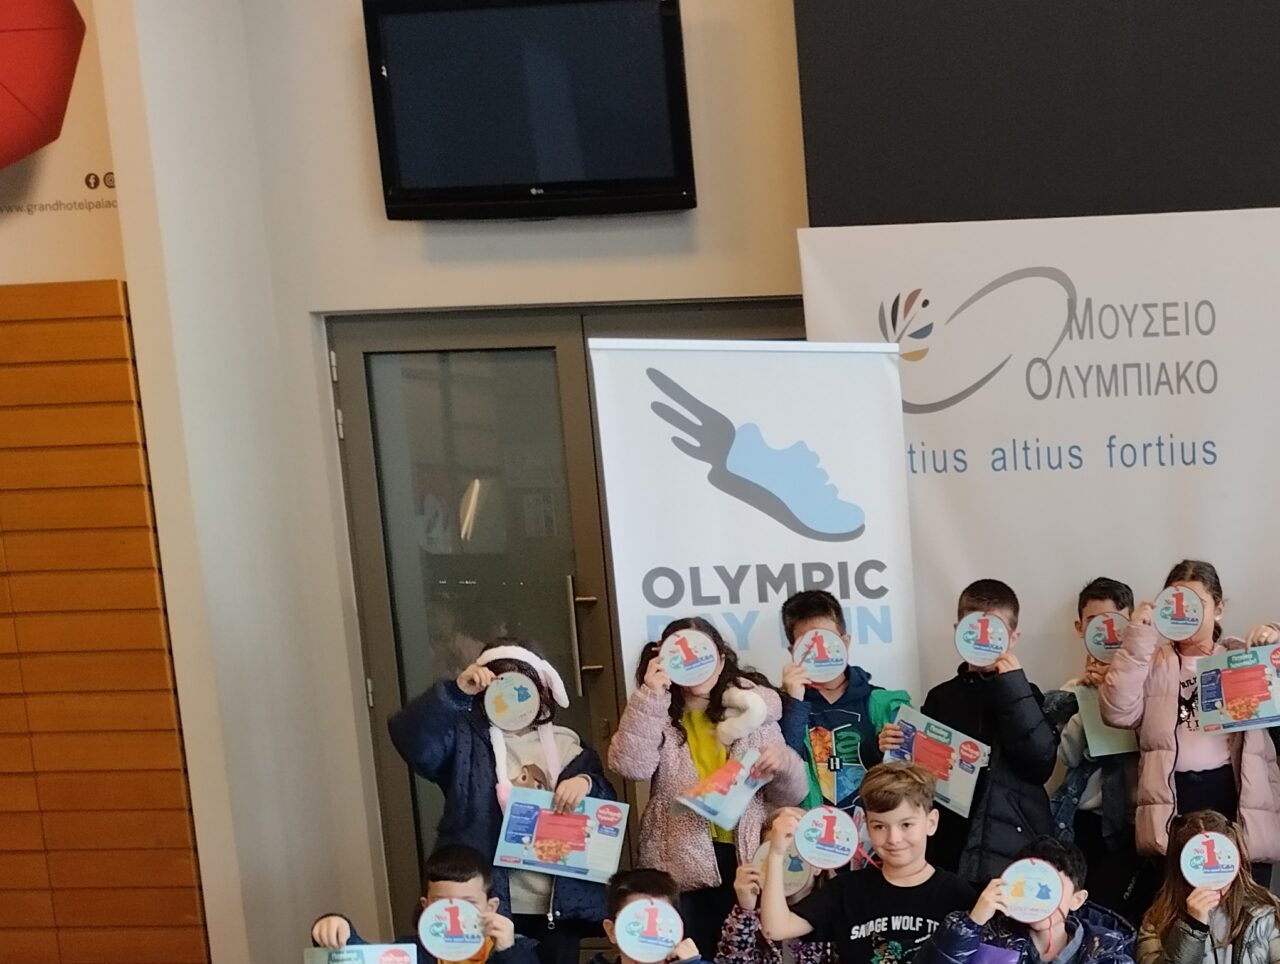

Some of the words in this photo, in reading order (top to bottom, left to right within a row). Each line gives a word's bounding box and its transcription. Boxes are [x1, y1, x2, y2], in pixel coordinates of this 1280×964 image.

[990, 437, 1085, 472] altius
[1106, 433, 1219, 469] fortius
[641, 559, 890, 609] OLYMPIC
[818, 815, 837, 846] 1
[1201, 839, 1219, 868] 1
[444, 905, 464, 936] 1
[891, 915, 923, 931] WOLF
